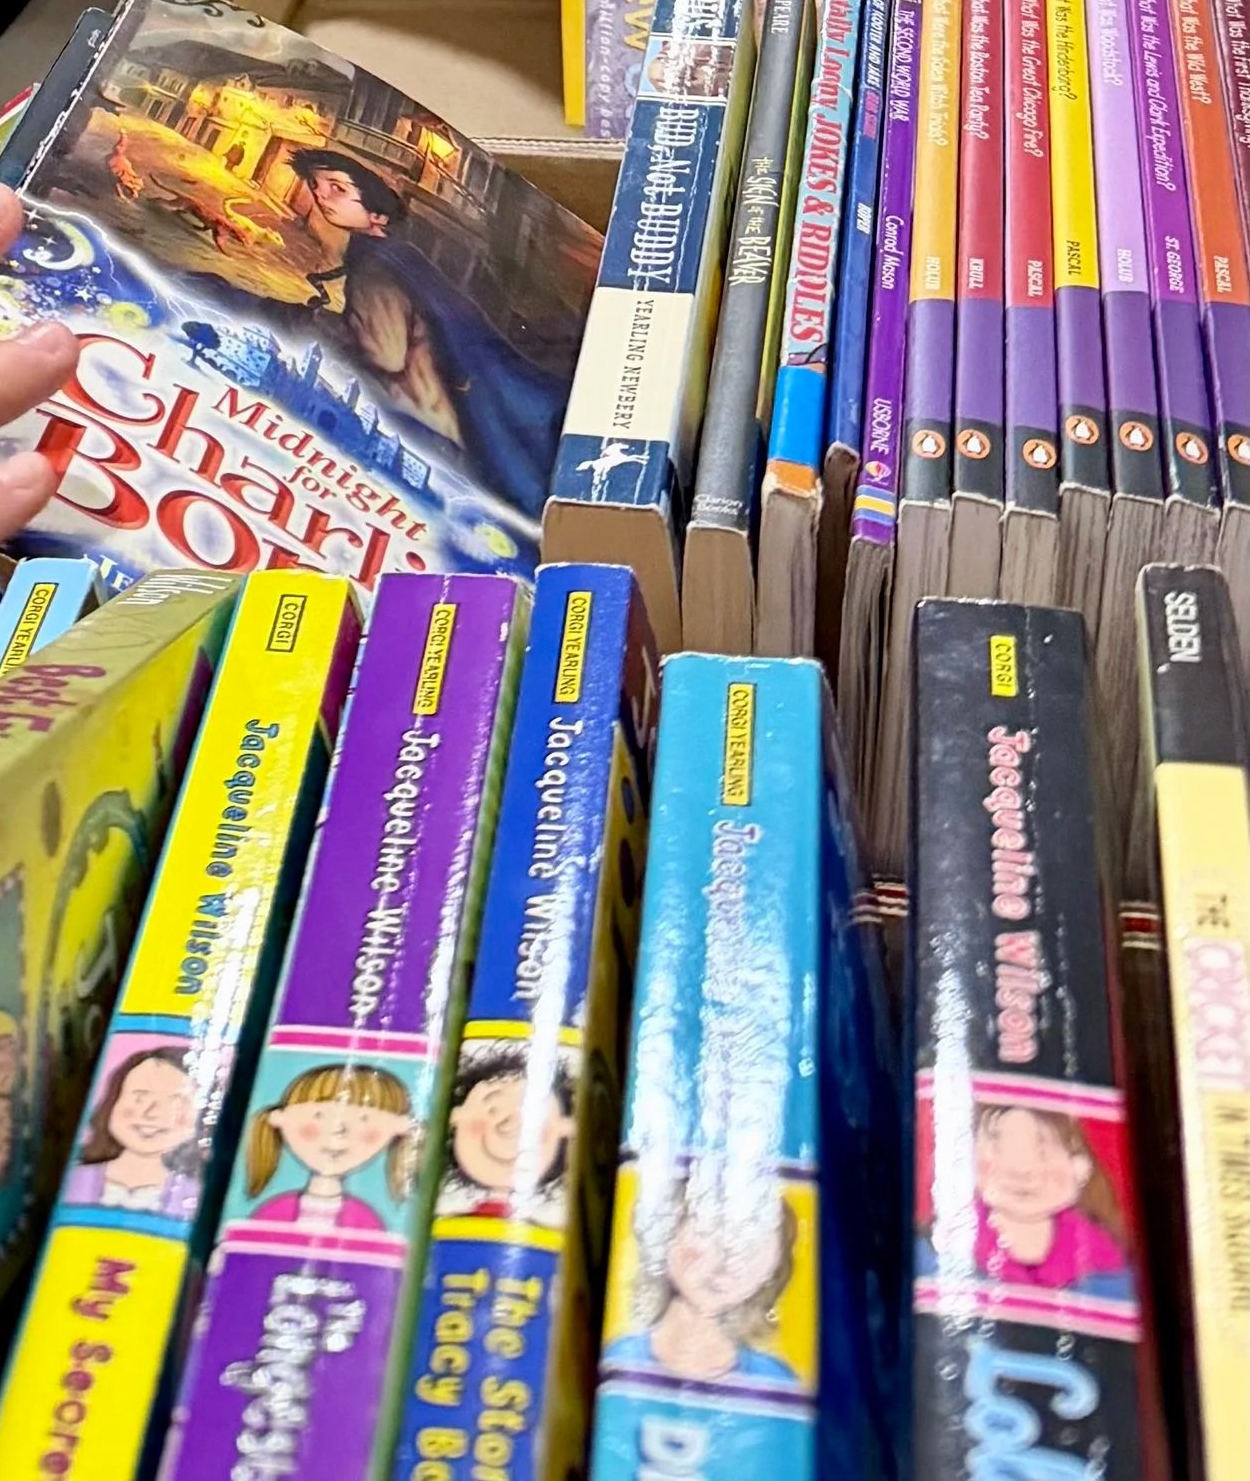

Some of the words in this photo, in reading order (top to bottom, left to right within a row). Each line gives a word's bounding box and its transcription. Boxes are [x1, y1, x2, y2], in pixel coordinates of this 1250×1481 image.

[898, 9, 915, 26] THE
[971, 14, 990, 33] Was
[1020, 19, 1040, 37] Was
[1055, 4, 1072, 22] Was
[1056, 23, 1073, 39] the
[1140, 14, 1158, 34] Was
[1181, 16, 1200, 35] Was
[1228, 20, 1247, 38] Was
[868, 43, 883, 65] AND
[894, 26, 913, 64] SECOND
[971, 34, 990, 51] the
[1021, 38, 1041, 54] the
[1100, 27, 1124, 87] Woodstock?
[1142, 33, 1161, 50] the
[1184, 35, 1203, 53] the
[1231, 39, 1250, 58] the
[890, 64, 912, 98] WORLD
[970, 51, 990, 84] Boston
[1022, 55, 1042, 86] Great
[1143, 50, 1162, 78] Lewis
[1186, 53, 1206, 76] Wild
[968, 85, 990, 104] Tea
[1146, 75, 1164, 98] and
[1188, 72, 1211, 105] West?
[889, 98, 910, 122] WAR
[963, 103, 990, 139] Party?
[1015, 85, 1043, 128] Chicago
[1148, 95, 1170, 128] Clark
[805, 112, 843, 194] JOKES
[1024, 126, 1044, 158] Fire?
[1146, 125, 1176, 192] Expedition?
[802, 195, 834, 216] &
[628, 201, 684, 285] BUDDY
[885, 215, 904, 250] Conrad
[729, 236, 773, 287] BEAVER
[1066, 239, 1082, 276] PASCAL
[1117, 248, 1134, 283] HOLUB
[1168, 251, 1184, 294] GEORGE
[1213, 255, 1232, 293] PASCAL
[790, 220, 832, 344] RIDDLES
[1028, 259, 1044, 297] PASCAL
[625, 299, 655, 362] YEARLING
[612, 365, 642, 430] NEWBERY
[870, 398, 892, 455] USBORNE
[212, 383, 428, 542] Midnight
[282, 464, 339, 503] for
[22, 588, 50, 625] CORGI
[273, 600, 300, 646] CORGI
[566, 595, 588, 636] CORGI
[428, 608, 451, 649] CORGI
[1163, 590, 1203, 664] SELDEN
[415, 649, 448, 711] YEARLING
[557, 636, 585, 697] YEARLING
[993, 641, 1013, 691] CORGI
[730, 689, 750, 731] CORGI
[725, 733, 749, 799] YEARLING
[204, 718, 281, 879] Jacqueline
[370, 728, 440, 894] Jacqueline
[527, 716, 584, 880] Jacqueline
[982, 724, 1031, 920] Jacqueline
[174, 892, 229, 996] Wilson
[349, 906, 405, 1015] Wilson
[511, 893, 564, 1001] Wilson
[994, 929, 1047, 1065] Wilson
[70, 1255, 137, 1321] My
[414, 1267, 491, 1407] Tracy
[482, 1276, 544, 1360] The
